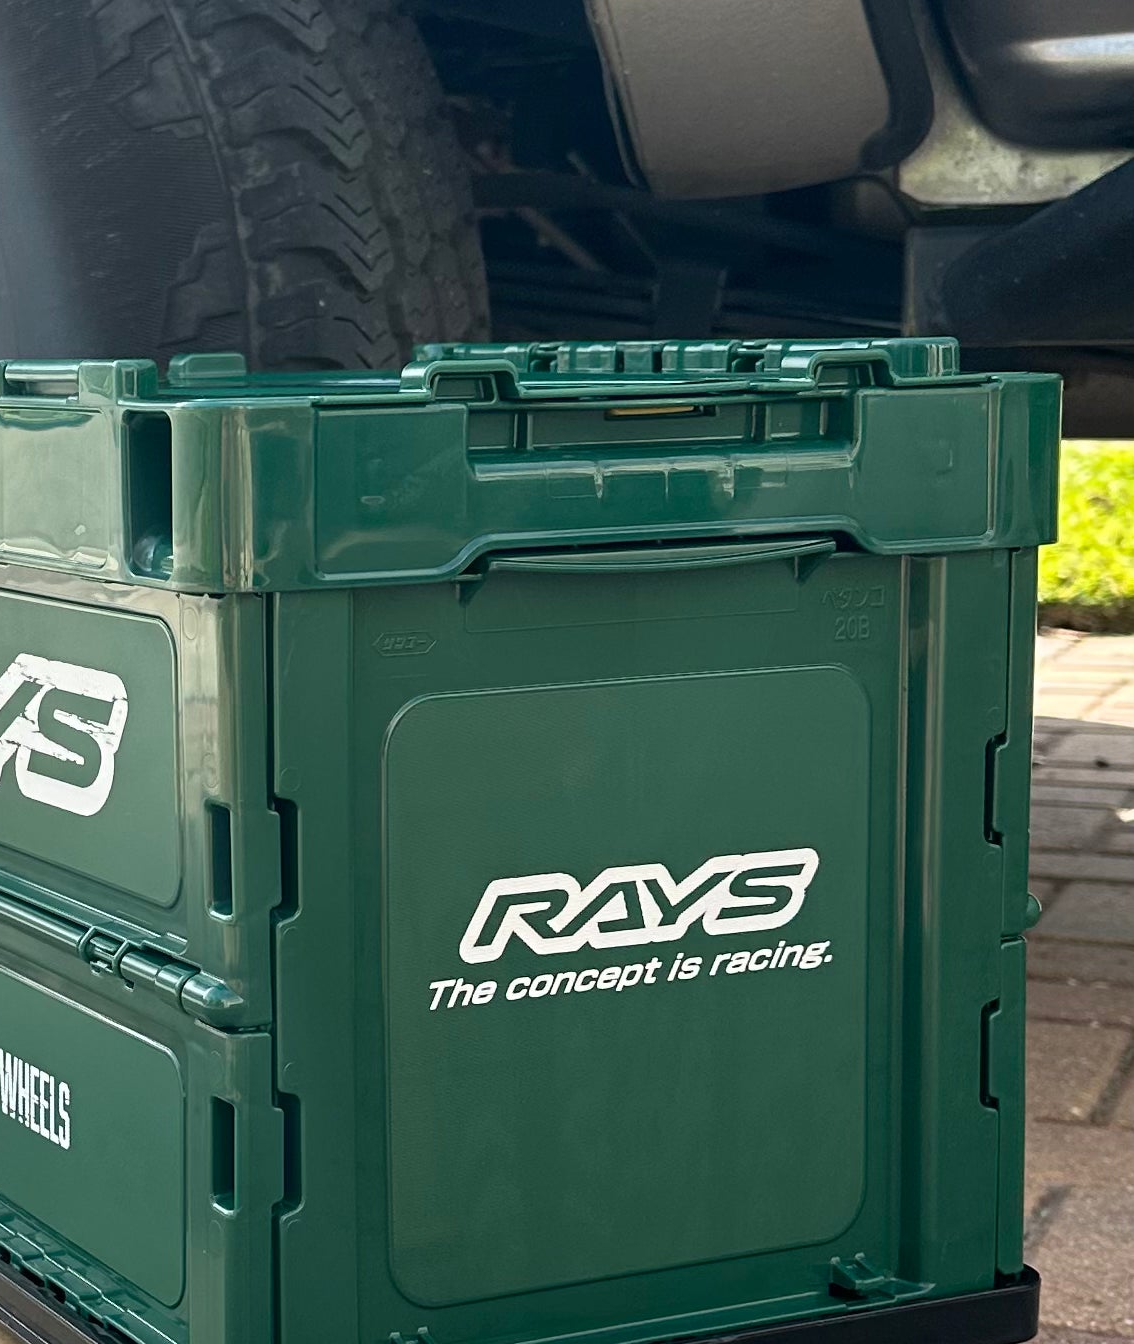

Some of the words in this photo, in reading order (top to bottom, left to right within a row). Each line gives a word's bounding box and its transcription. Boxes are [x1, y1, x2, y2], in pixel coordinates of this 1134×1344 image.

[834, 614, 871, 641] 20B
[458, 847, 820, 964] RAYS
[428, 979, 495, 1012] The
[505, 957, 660, 1002] concept
[666, 951, 700, 981] is
[709, 938, 834, 976] racing.
[0, 1049, 72, 1150] WHEELS
